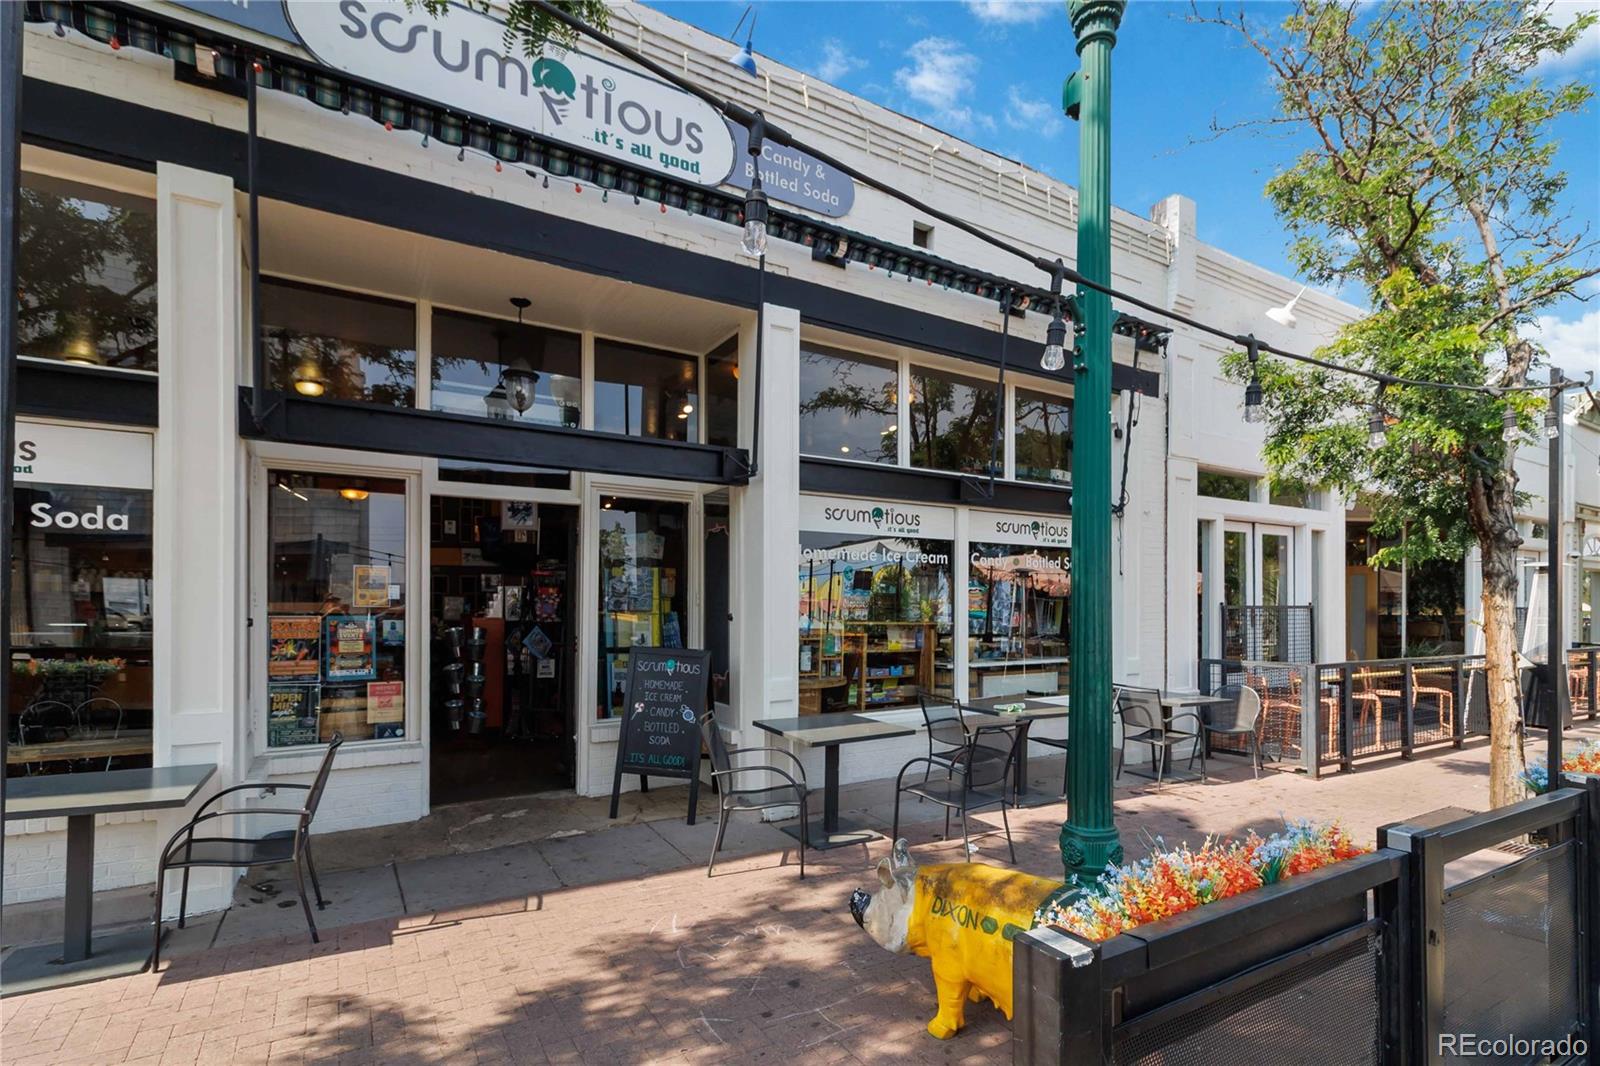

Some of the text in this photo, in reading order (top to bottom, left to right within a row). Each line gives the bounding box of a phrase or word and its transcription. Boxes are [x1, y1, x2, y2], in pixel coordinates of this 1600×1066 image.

[339, 0, 704, 154] scrumptious
[630, 142, 652, 160] all
[659, 152, 701, 175] good
[761, 145, 825, 180] Candy &
[745, 162, 839, 206] Bottled Soda
[30, 502, 129, 531] Soda
[825, 507, 921, 529] scrumptious
[996, 521, 1068, 540] scrumptious
[799, 544, 948, 565] omemade Ice Cream
[970, 552, 1007, 570] Candy
[1026, 555, 1061, 569] Bottled
[644, 680, 683, 691] HOMEMADE
[273, 693, 303, 702] OPEN
[644, 692, 682, 702] ICE CREAM
[650, 707, 674, 717] CANDY
[644, 721, 680, 734] BOTTLED
[649, 735, 671, 745] SODA
[648, 754, 660, 764] ALL
[931, 896, 979, 930] DIXON
